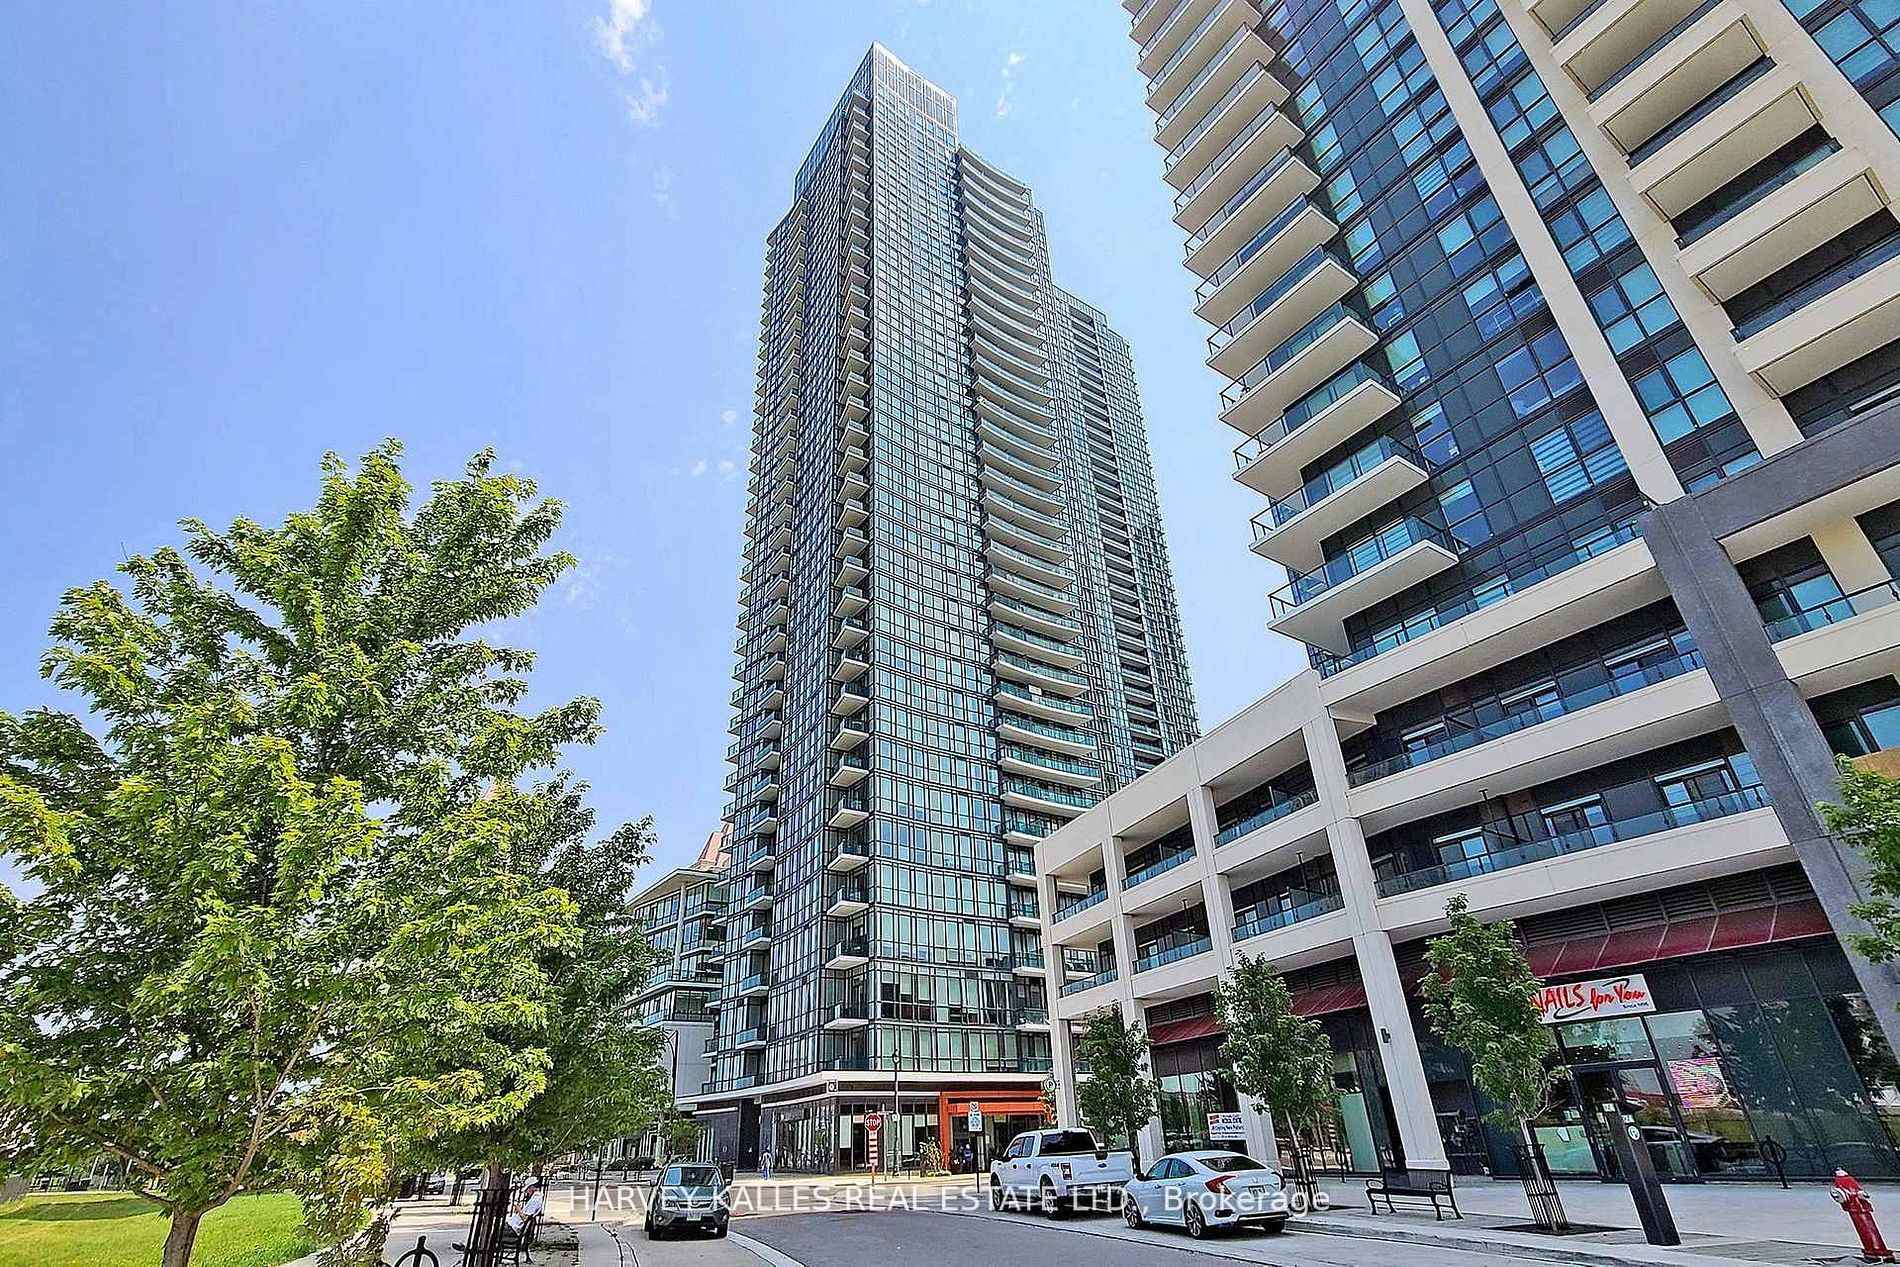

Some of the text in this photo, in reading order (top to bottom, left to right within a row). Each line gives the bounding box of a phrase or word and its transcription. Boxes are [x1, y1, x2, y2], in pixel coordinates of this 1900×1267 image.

[1590, 988, 1614, 1012] for
[1613, 983, 1645, 1003] You
[865, 1118, 881, 1126] STOP
